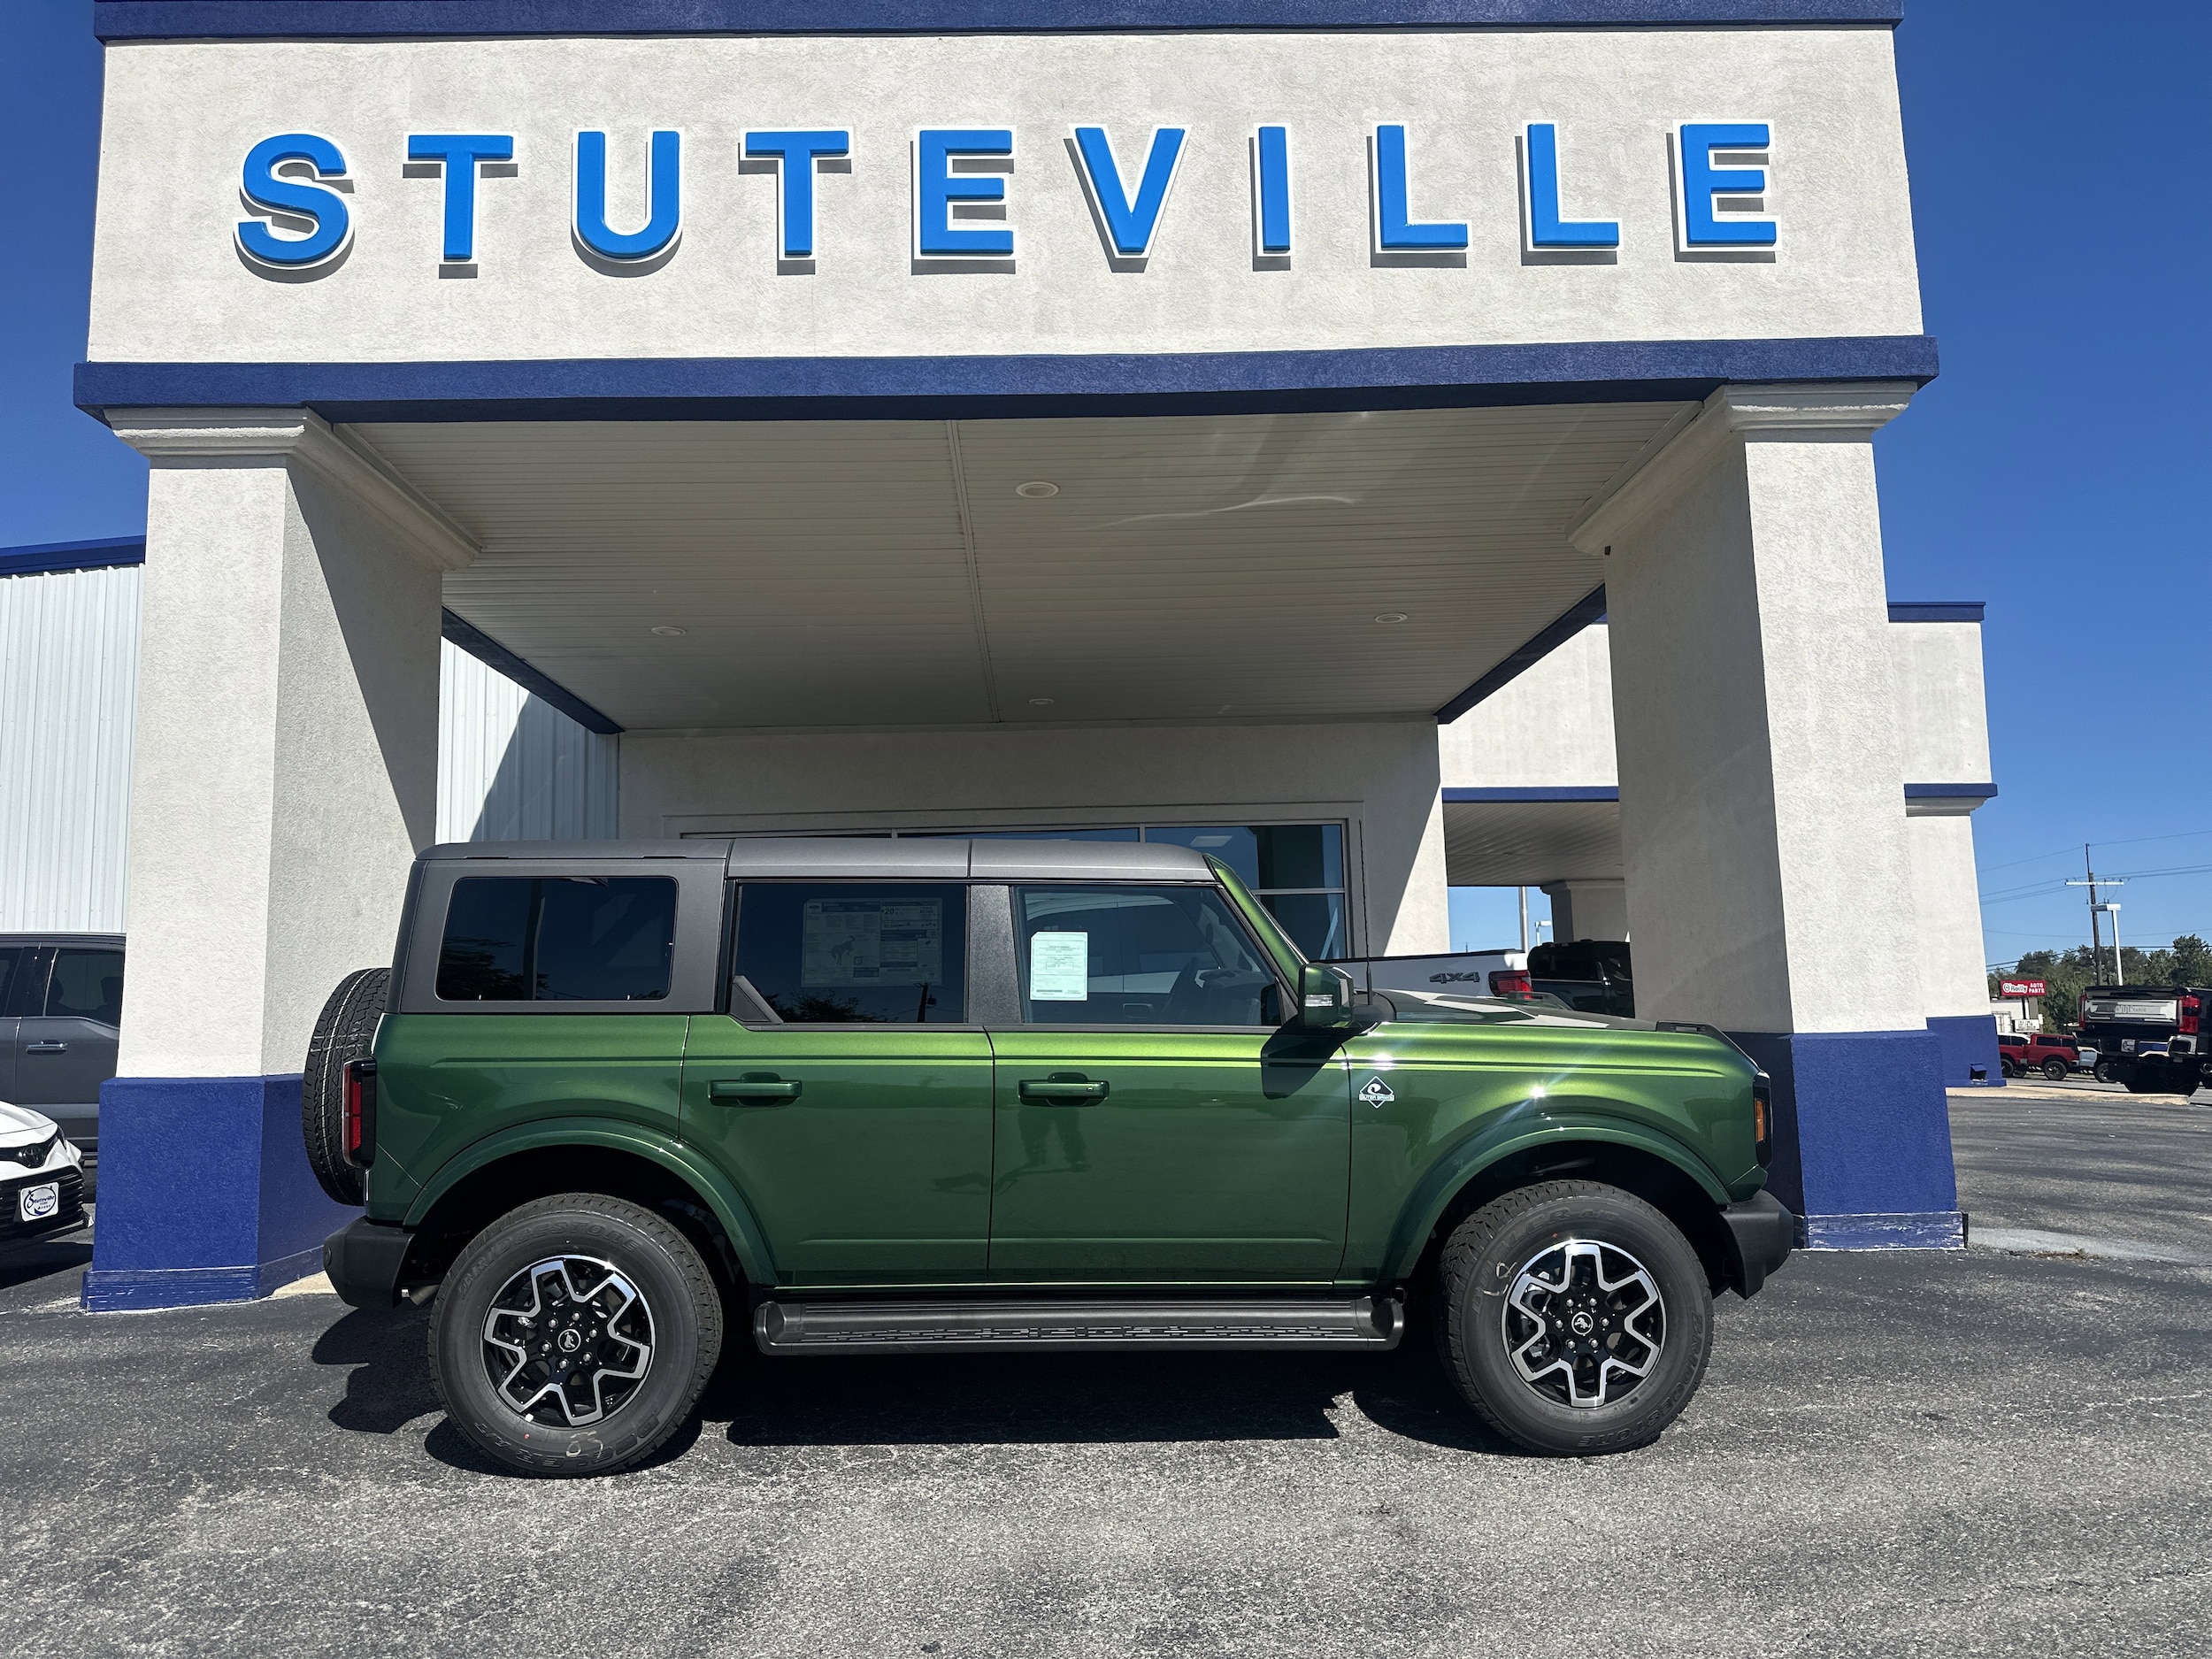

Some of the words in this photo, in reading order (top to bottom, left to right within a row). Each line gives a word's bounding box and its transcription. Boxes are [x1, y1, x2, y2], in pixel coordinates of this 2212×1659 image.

[233, 119, 1782, 273] STUTEVILLE
[2002, 982, 2028, 994] O'Reilly
[459, 1221, 642, 1296] BRIDGESTONE
[1578, 1311, 1704, 1448] BRIDGESTONE
